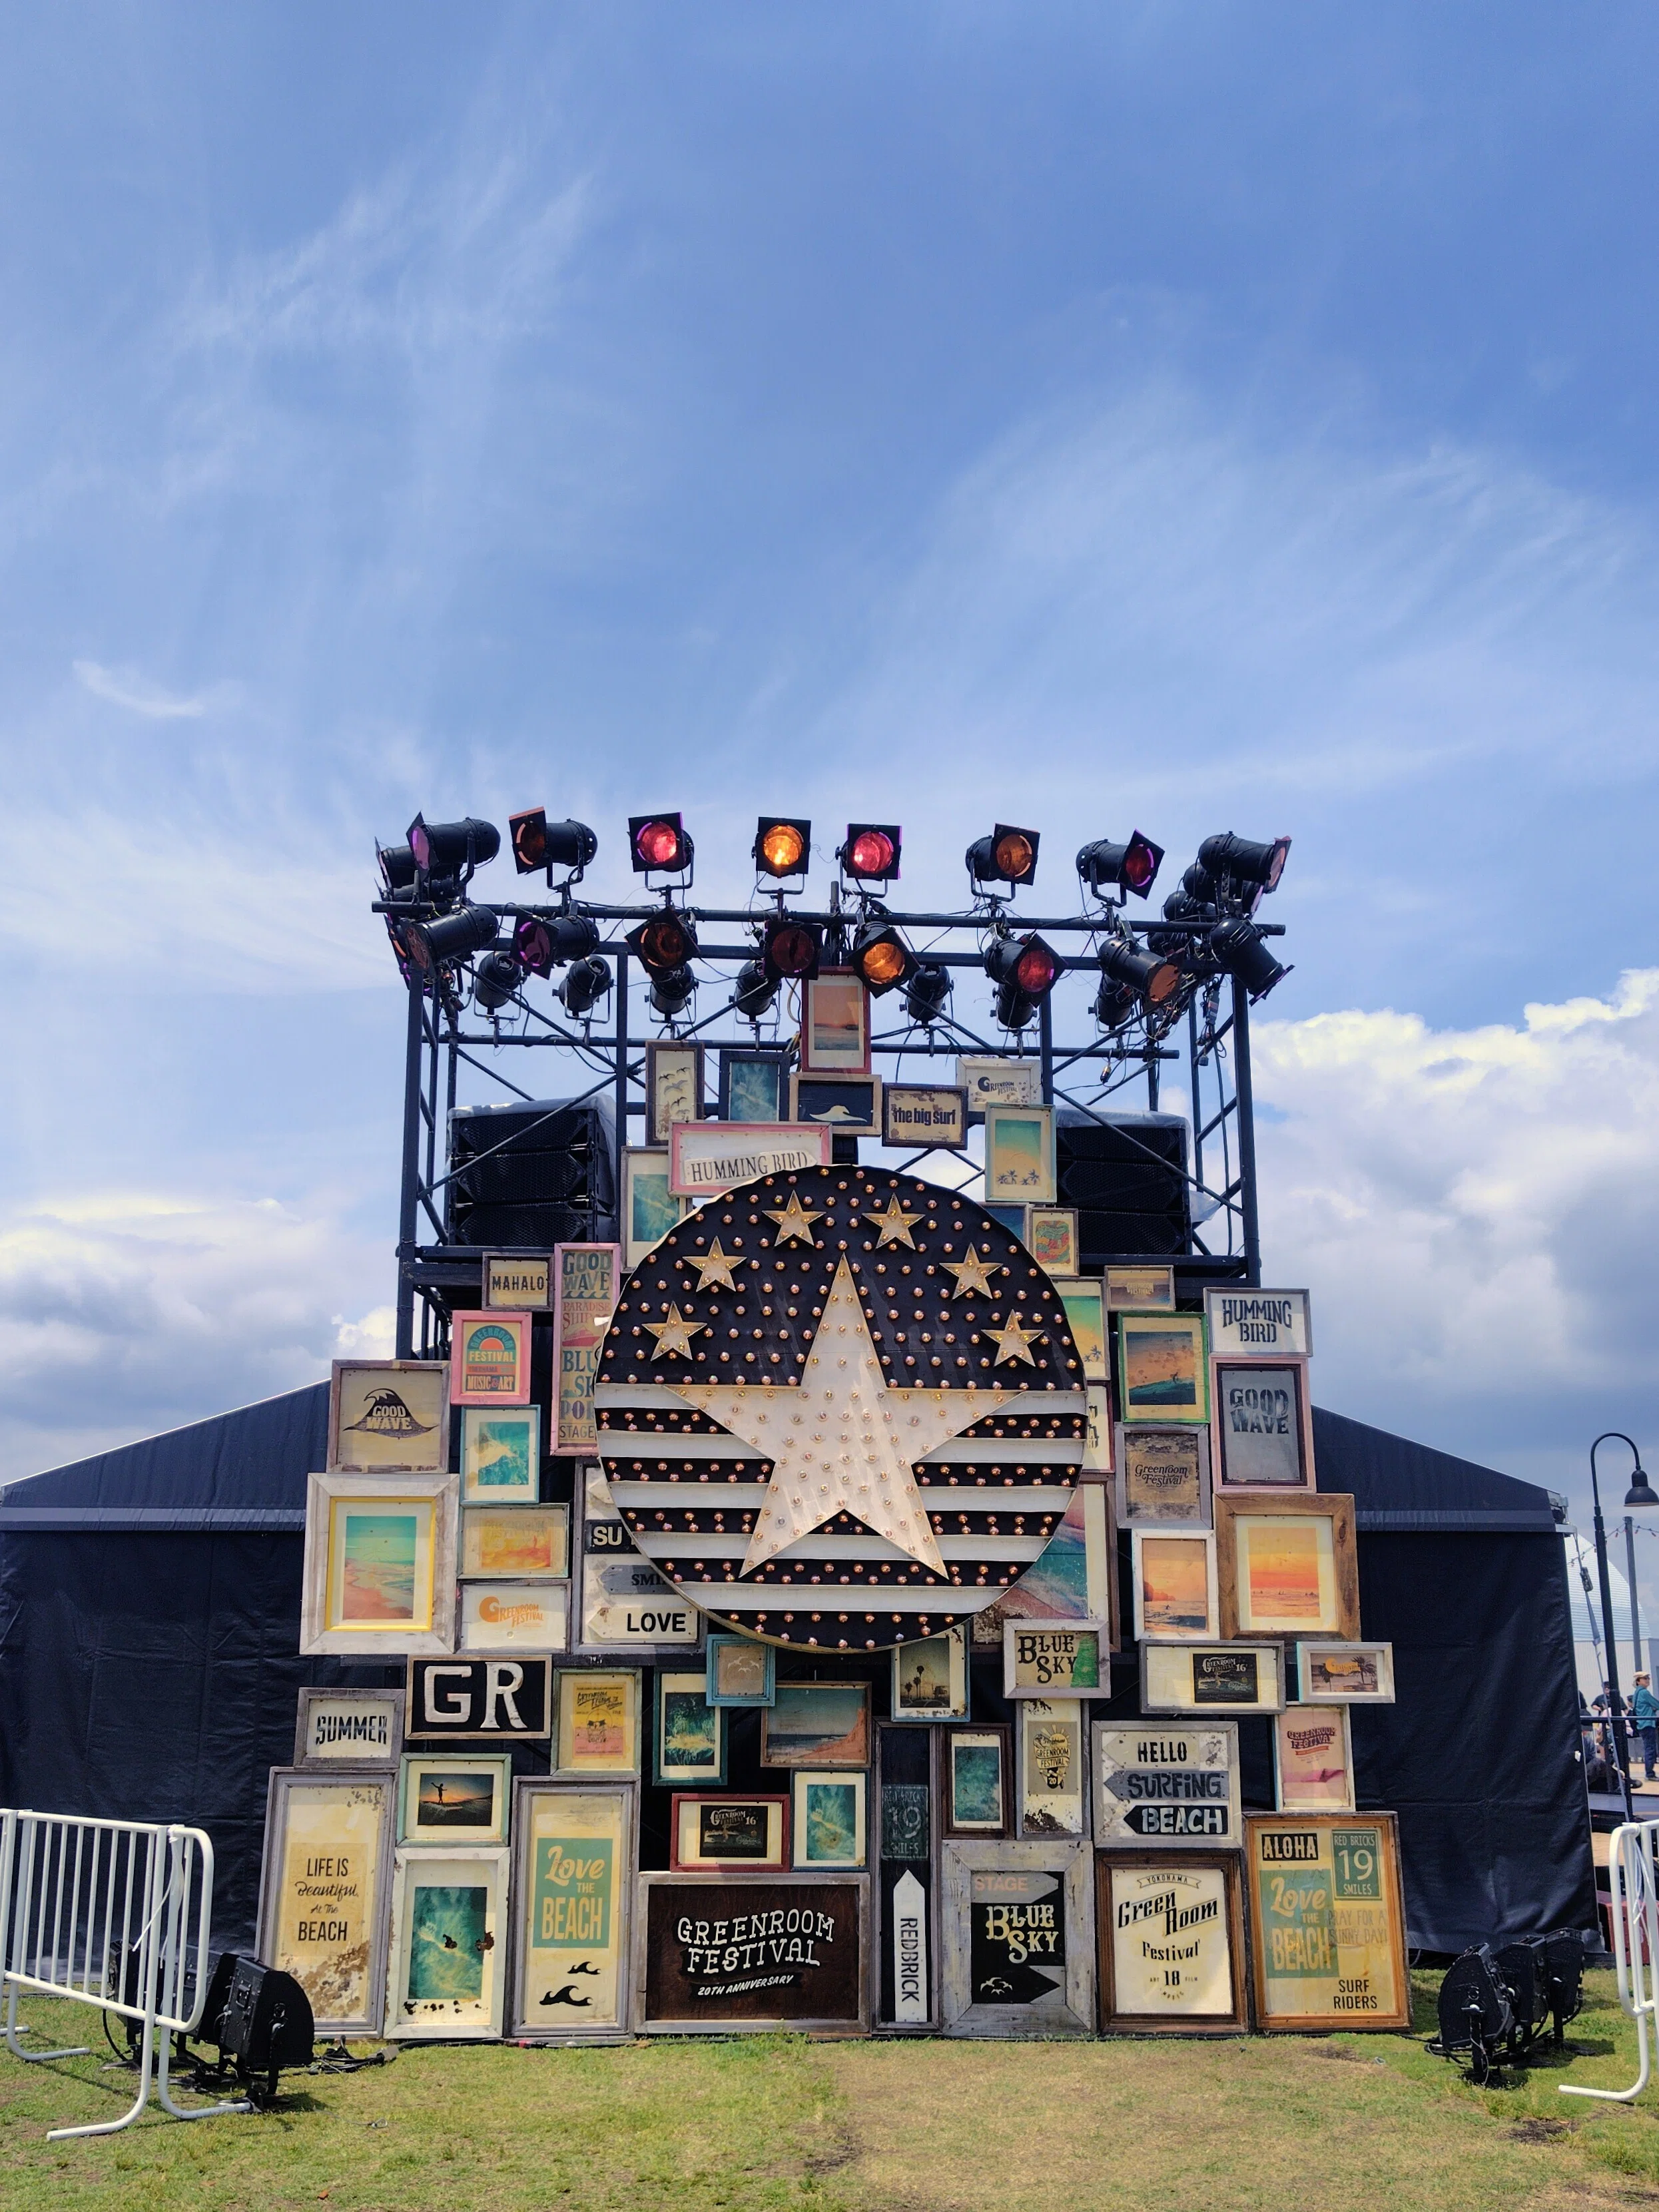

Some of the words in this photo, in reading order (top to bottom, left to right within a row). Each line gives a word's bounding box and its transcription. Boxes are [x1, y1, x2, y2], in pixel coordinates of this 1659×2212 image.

[978, 1076, 1015, 1092] GREENROOM
[893, 1107, 912, 1123] the
[914, 1108, 932, 1126] big
[932, 1109, 956, 1125] surf
[691, 1155, 768, 1183] HUMMING
[772, 1152, 809, 1171] BIRD
[563, 1252, 611, 1276] GOOD
[492, 1275, 545, 1290] MAHALO
[563, 1271, 611, 1292] WAVE
[563, 1301, 611, 1312] PARADISE
[1221, 1299, 1292, 1329] HUMMING
[1239, 1322, 1277, 1343] BIRD
[469, 1350, 515, 1362] FESTIVAL
[467, 1375, 492, 1390] MUSIC
[498, 1375, 514, 1390] ART
[372, 1405, 406, 1418] GOOD
[1229, 1388, 1289, 1416] GOOD
[366, 1417, 412, 1430] WAVE
[1230, 1408, 1289, 1434] WAVE
[559, 1425, 595, 1439] STAGE
[1135, 1464, 1189, 1479] Greenroom
[1142, 1474, 1183, 1488] Festival
[479, 1596, 539, 1623] GREENROOM
[511, 1611, 544, 1628] FESTIVAL
[627, 1613, 687, 1632] LOVE
[1017, 1634, 1075, 1664] BLUE
[1036, 1655, 1078, 1684] SKY
[424, 1661, 529, 1729] GR
[316, 1715, 388, 1745] SUMMER
[1036, 1747, 1069, 1757] GREENROOM
[1040, 1757, 1066, 1768] FESTIVAL
[1138, 1741, 1187, 1763] HELLO
[888, 1805, 922, 1838] 19
[1142, 1807, 1223, 1834] BEACH
[1263, 1836, 1317, 1859] ALOHA
[1334, 1835, 1347, 1846] RED
[1350, 1835, 1375, 1846] BRICKS
[306, 1858, 334, 1877] LIFE
[336, 1858, 349, 1877] IS
[545, 1845, 605, 1886] Love
[1338, 1849, 1373, 1880] 19
[576, 1882, 595, 1894] THE
[974, 1875, 1029, 1892] STAGE
[1146, 1874, 1188, 1884] YOKOHAMA
[1343, 1883, 1372, 1895] SMILES
[1270, 1876, 1327, 1918] Love
[310, 1904, 322, 1914] At
[324, 1904, 339, 1914] The
[541, 1896, 603, 1940] BEACH
[1165, 1900, 1218, 1936] Room
[1301, 1912, 1320, 1924] THE
[1357, 1910, 1373, 1926] FOR
[298, 1921, 348, 1942] BEACH
[677, 1908, 834, 1946] GREENROOM
[985, 1904, 1055, 1940] BLUE
[687, 1938, 821, 1974] FESTIVAL
[1007, 1930, 1059, 1964] SKY
[1271, 1927, 1331, 1971] BEACH
[900, 1918, 920, 2002] REDBRICK
[698, 1984, 725, 1996] 20TH
[725, 1975, 795, 1994] ANNIVERSARY
[1164, 1970, 1180, 1986] 18
[1338, 1979, 1370, 1993] SURF
[1333, 1995, 1378, 2010] RIDERS
